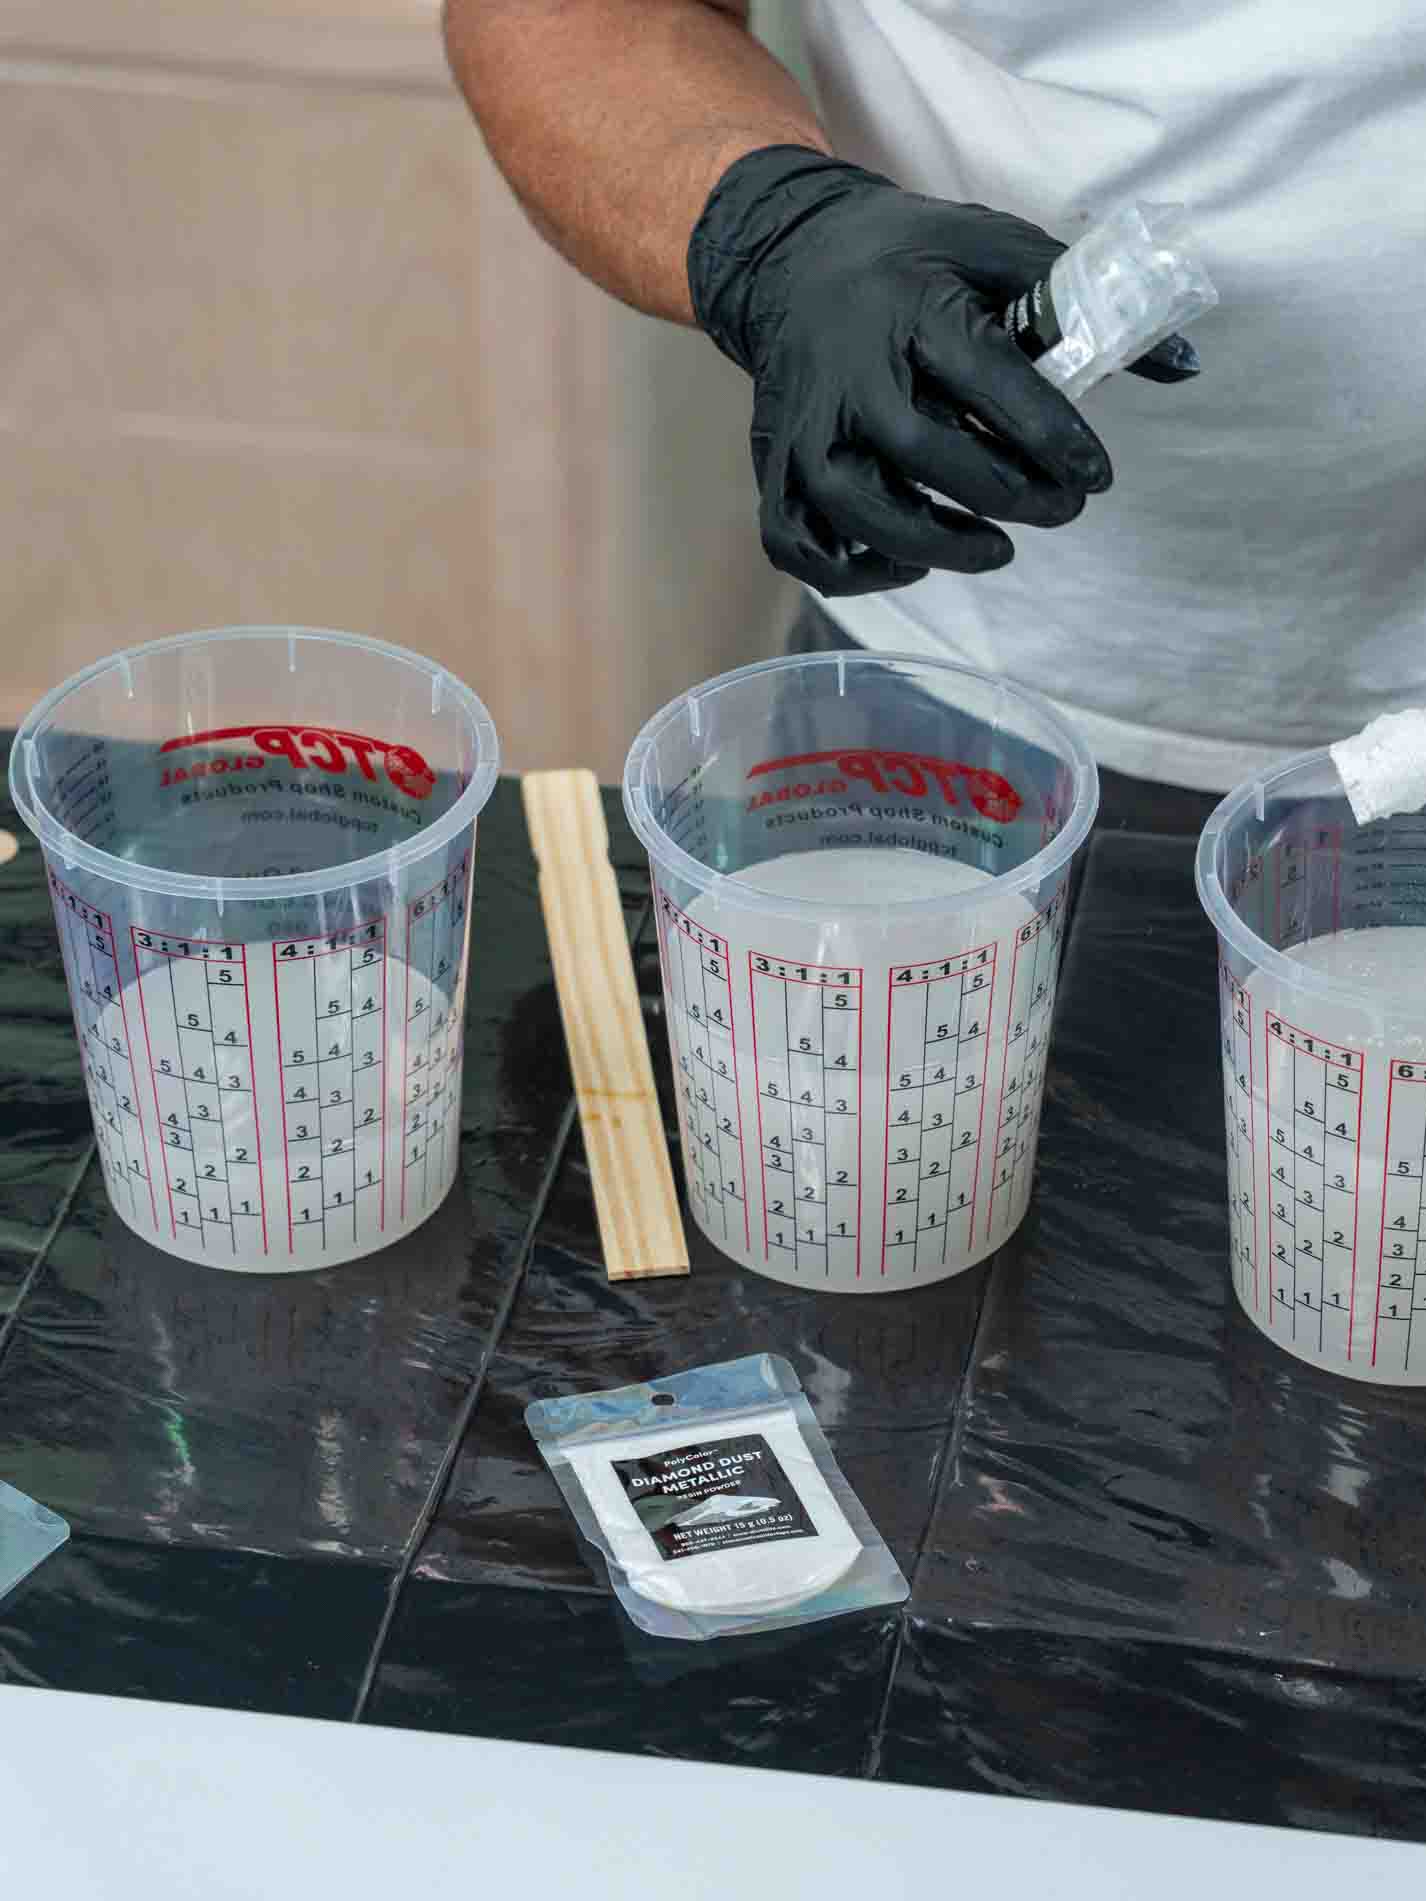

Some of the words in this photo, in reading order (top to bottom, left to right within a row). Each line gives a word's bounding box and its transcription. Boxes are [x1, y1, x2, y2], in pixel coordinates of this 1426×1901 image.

[363, 948, 375, 963] 5
[710, 959, 719, 973] 5
[219, 969, 232, 982] 5
[973, 974, 983, 988] 5
[328, 1000, 339, 1014] 5
[362, 997, 374, 1010] 4
[835, 994, 847, 1007] 5
[188, 1014, 199, 1027] 5
[713, 1009, 723, 1022] 4
[937, 1024, 948, 1038] 5
[968, 1022, 979, 1034] 4
[224, 1031, 237, 1044] 4
[800, 1038, 811, 1051] 5
[293, 1050, 304, 1063] 5
[363, 1051, 374, 1065] 3
[835, 1055, 847, 1067] 4
[160, 1059, 171, 1073] 5
[194, 1067, 205, 1080] 4
[229, 1076, 240, 1088] 3
[900, 1074, 911, 1087] 5
[965, 1075, 975, 1088] 3
[1337, 1074, 1348, 1087] 5
[294, 1087, 307, 1099] 4
[768, 1083, 778, 1096] 5
[330, 1090, 342, 1103] 3
[198, 1105, 209, 1118] 3
[836, 1099, 847, 1112] 3
[1304, 1101, 1314, 1115] 5
[168, 1113, 178, 1125] 4
[364, 1108, 374, 1123] 2
[897, 1110, 910, 1122] 4
[932, 1113, 943, 1126] 3
[296, 1126, 308, 1138] 3
[1335, 1123, 1346, 1135] 4
[170, 1132, 180, 1145] 3
[770, 1136, 781, 1148] 4
[960, 1131, 971, 1145] 2
[1276, 1129, 1285, 1143] 5
[332, 1139, 343, 1152] 2
[1303, 1145, 1313, 1158] 4
[236, 1148, 247, 1161] 2
[772, 1154, 782, 1167] 3
[897, 1148, 908, 1160] 3
[205, 1165, 216, 1177] 2
[298, 1166, 310, 1179] 2
[929, 1162, 940, 1175] 2
[1276, 1167, 1285, 1179] 4
[1397, 1161, 1409, 1174] 5
[837, 1171, 848, 1183] 2
[177, 1178, 186, 1192] 2
[804, 1187, 814, 1199] 2
[896, 1189, 907, 1201] 2
[241, 1201, 249, 1213] 1
[774, 1202, 784, 1213] 2
[1277, 1206, 1286, 1218] 3
[301, 1208, 309, 1220] 1
[838, 1223, 845, 1234] 1
[1393, 1216, 1406, 1228] 4
[896, 1230, 903, 1242] 1
[1333, 1231, 1344, 1245] 2
[1277, 1245, 1286, 1259] 2
[1303, 1240, 1312, 1254] 2
[1392, 1244, 1403, 1256] 3
[1389, 1274, 1401, 1286] 2
[1332, 1293, 1339, 1305] 1
[1389, 1305, 1397, 1317] 1
[631, 1462, 714, 1487] DIAMOND
[719, 1451, 762, 1467] DUST
[662, 1466, 744, 1493] METALLIC
[704, 1480, 741, 1494] POWDER
[673, 1531, 692, 1541] NET
[694, 1524, 732, 1536] WEIGHT
